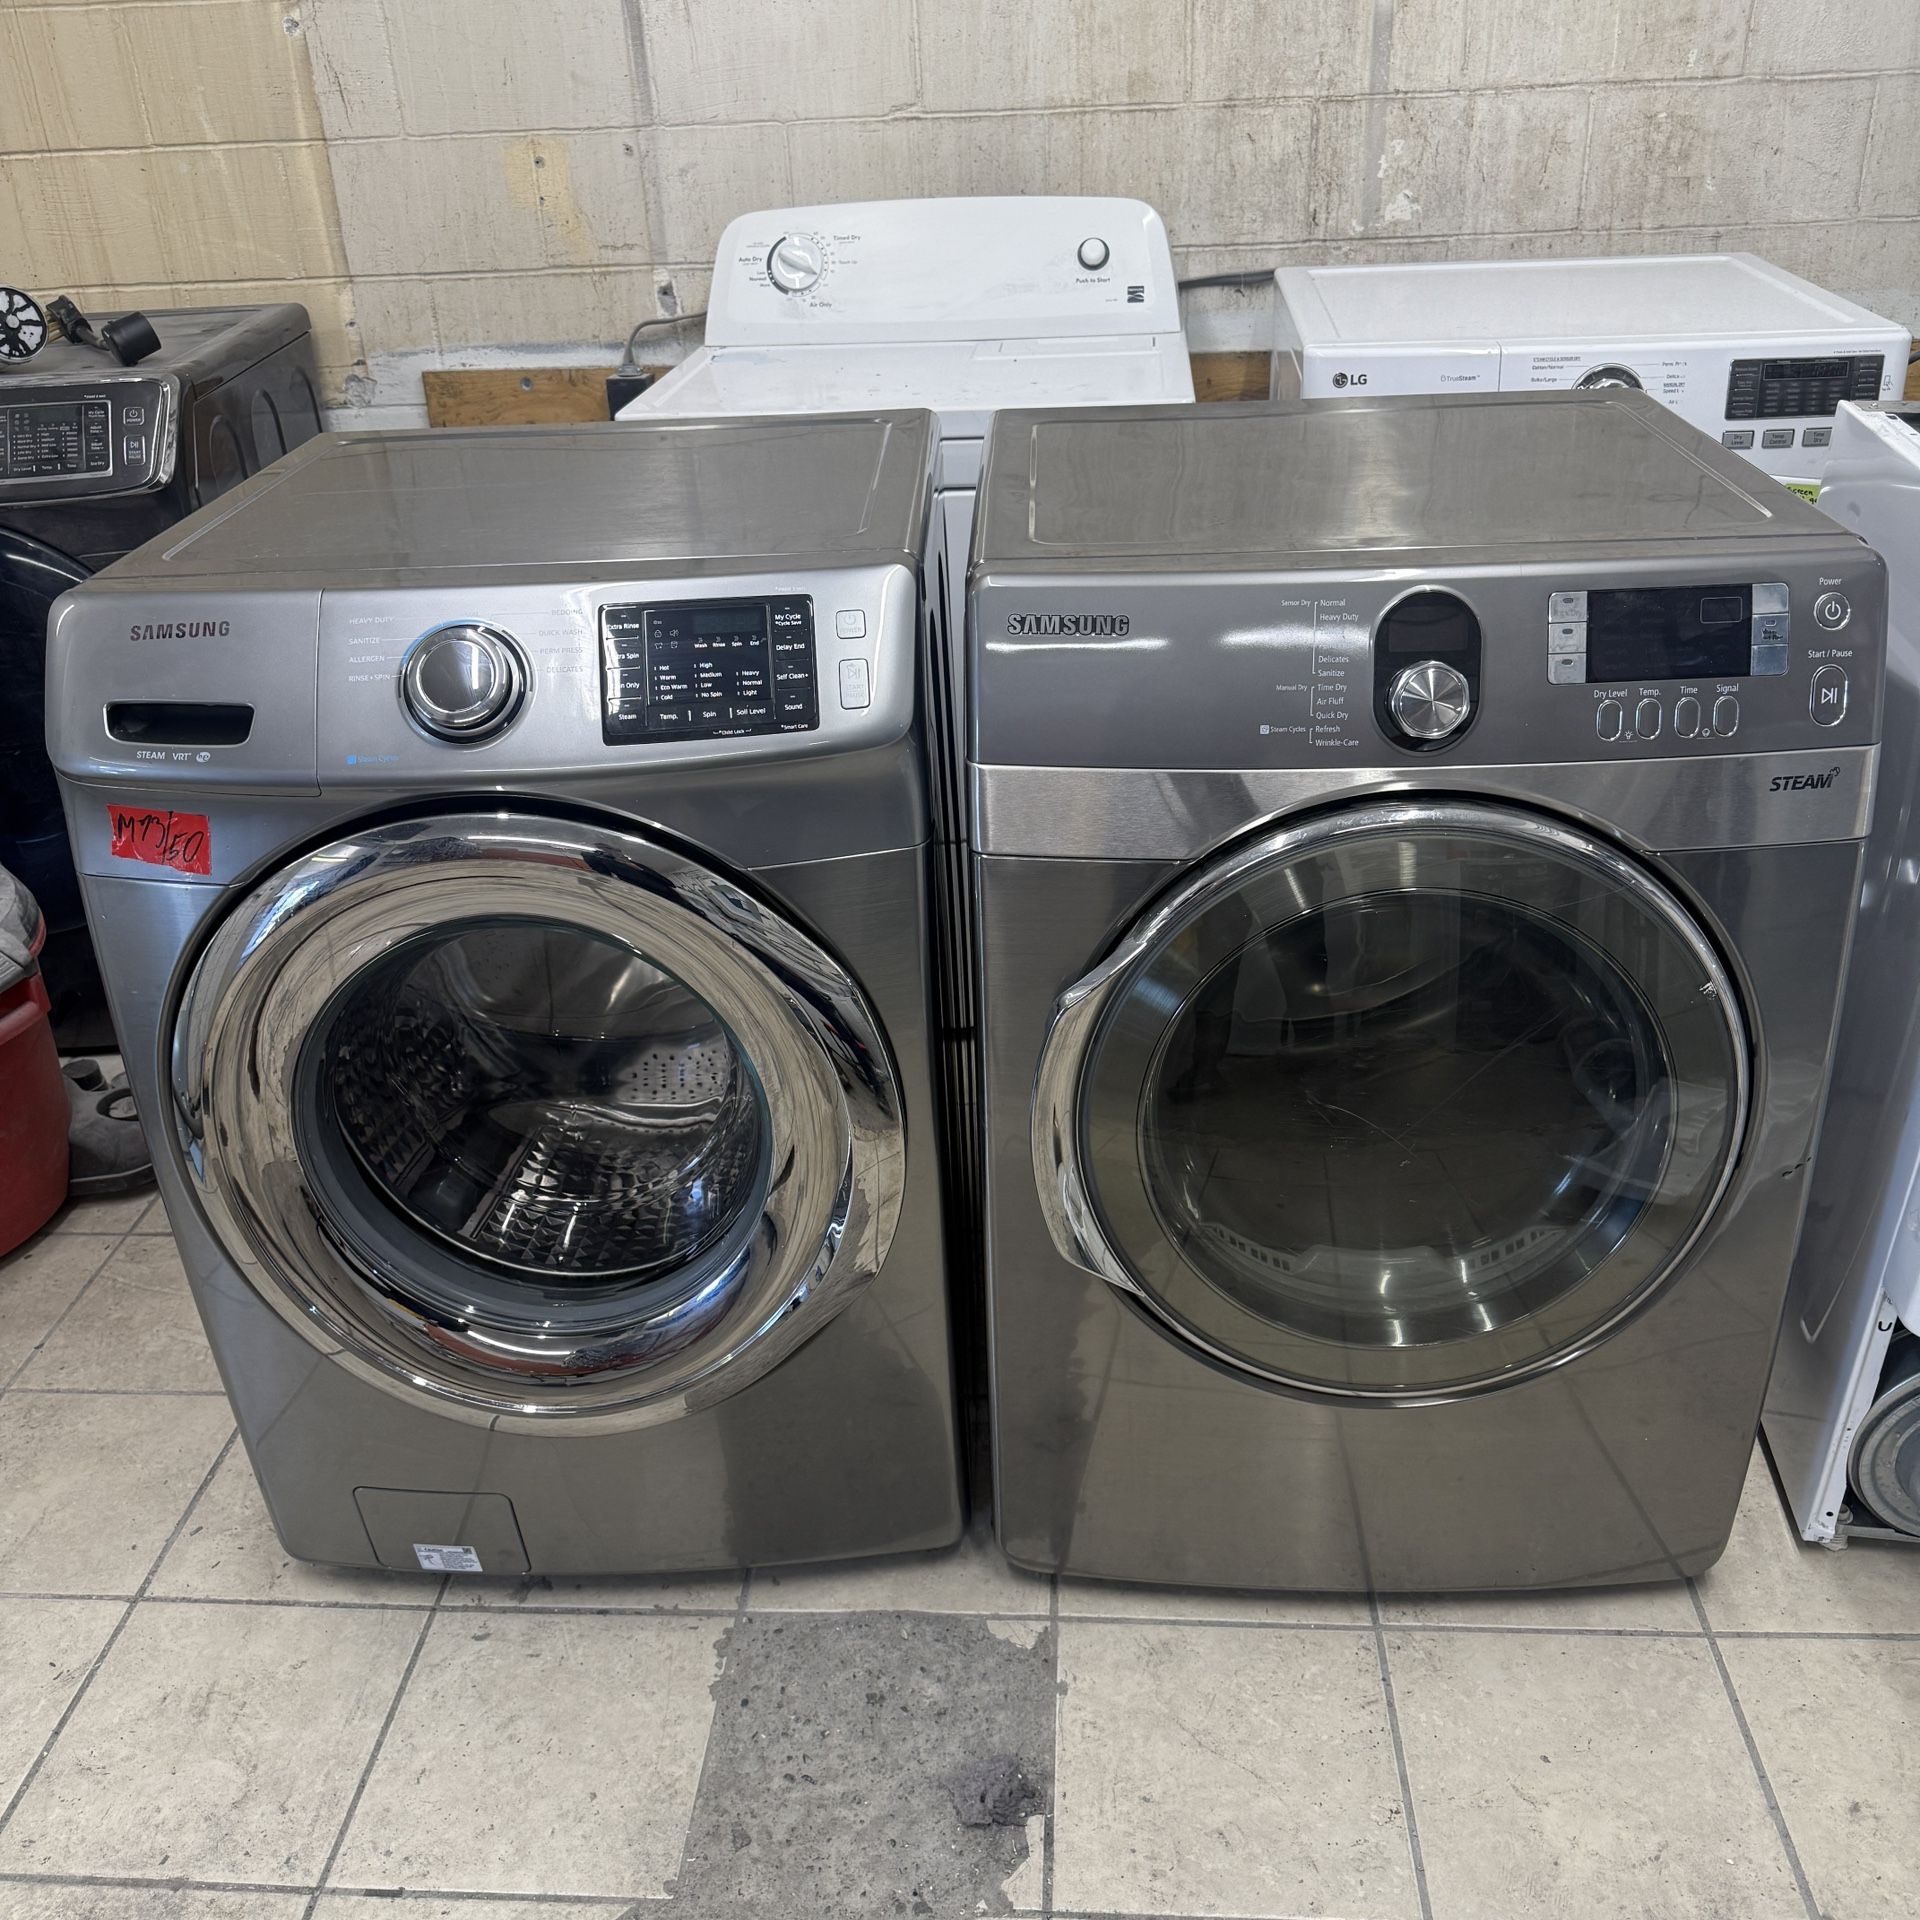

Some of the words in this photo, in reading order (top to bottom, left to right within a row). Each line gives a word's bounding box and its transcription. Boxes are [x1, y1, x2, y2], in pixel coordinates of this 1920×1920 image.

[1350, 374, 1368, 386] LG
[1819, 577, 1842, 586] Power
[1301, 600, 1311, 608] Dry
[1320, 599, 1346, 607] Normal
[349, 617, 373, 625] HEAVY
[785, 613, 801, 621] Cycle
[1320, 614, 1341, 622] Heavy
[1342, 613, 1359, 622] Duty
[1008, 614, 1129, 636] SAMSUNG
[130, 621, 230, 642] SAMSUNG
[348, 637, 381, 646] SANITIZE
[1808, 649, 1825, 659] Start
[1832, 649, 1853, 658] Pause
[1318, 655, 1350, 663] Delicates
[546, 666, 584, 674] DELICATES
[1318, 669, 1345, 677] Sanitize
[626, 682, 640, 690] Only
[1298, 684, 1308, 692] Dry
[1335, 684, 1348, 692] Dry
[1680, 685, 1698, 695] Time
[1716, 684, 1739, 695] Signal
[1594, 690, 1607, 700] Dry
[1609, 688, 1628, 698] Level
[1639, 688, 1662, 697] Temp.
[1328, 697, 1345, 705] Fluff
[702, 710, 717, 718] Spin
[736, 708, 748, 716] Soil
[618, 713, 637, 721] Steam
[1316, 712, 1335, 720] Quick
[1337, 712, 1349, 721] Dry
[1289, 726, 1307, 734] Cycles
[1315, 725, 1341, 733] Refresh
[1315, 739, 1359, 747] Wrinkle-Care
[137, 750, 166, 760] STEAM
[172, 752, 189, 761] VRT
[1770, 774, 1834, 792] STEAM
